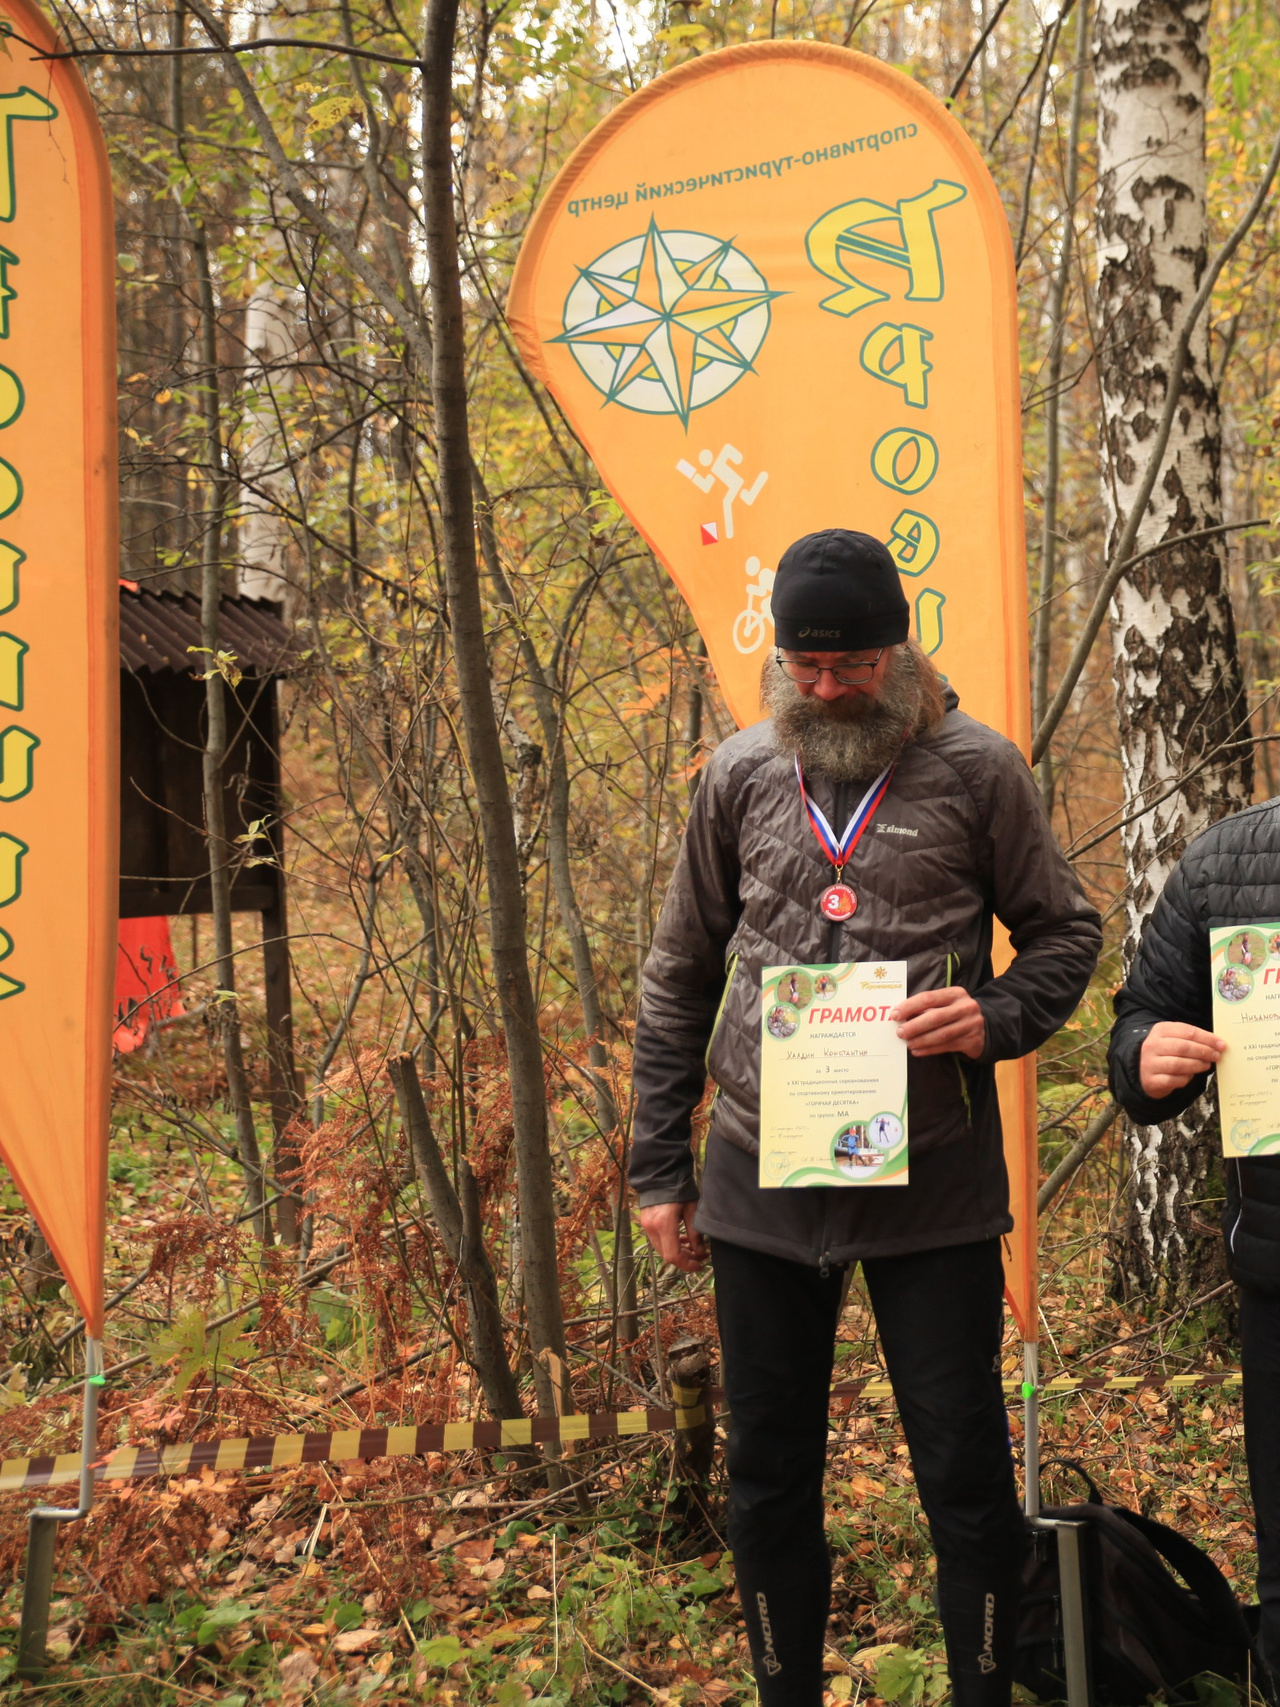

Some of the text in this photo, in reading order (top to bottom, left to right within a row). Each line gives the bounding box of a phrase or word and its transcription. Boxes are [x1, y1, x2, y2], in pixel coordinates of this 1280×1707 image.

[811, 629, 841, 638] asics
[886, 824, 919, 837] simond
[828, 894, 840, 909] 3
[808, 1005, 893, 1024] ГРАМОТ
[810, 1031, 857, 1040] НАГРАЖДАЕТСЯ
[823, 1047, 868, 1057] Константин
[825, 1065, 831, 1073] 3
[756, 1591, 776, 1653] NORD
[983, 1592, 995, 1653] NORD
